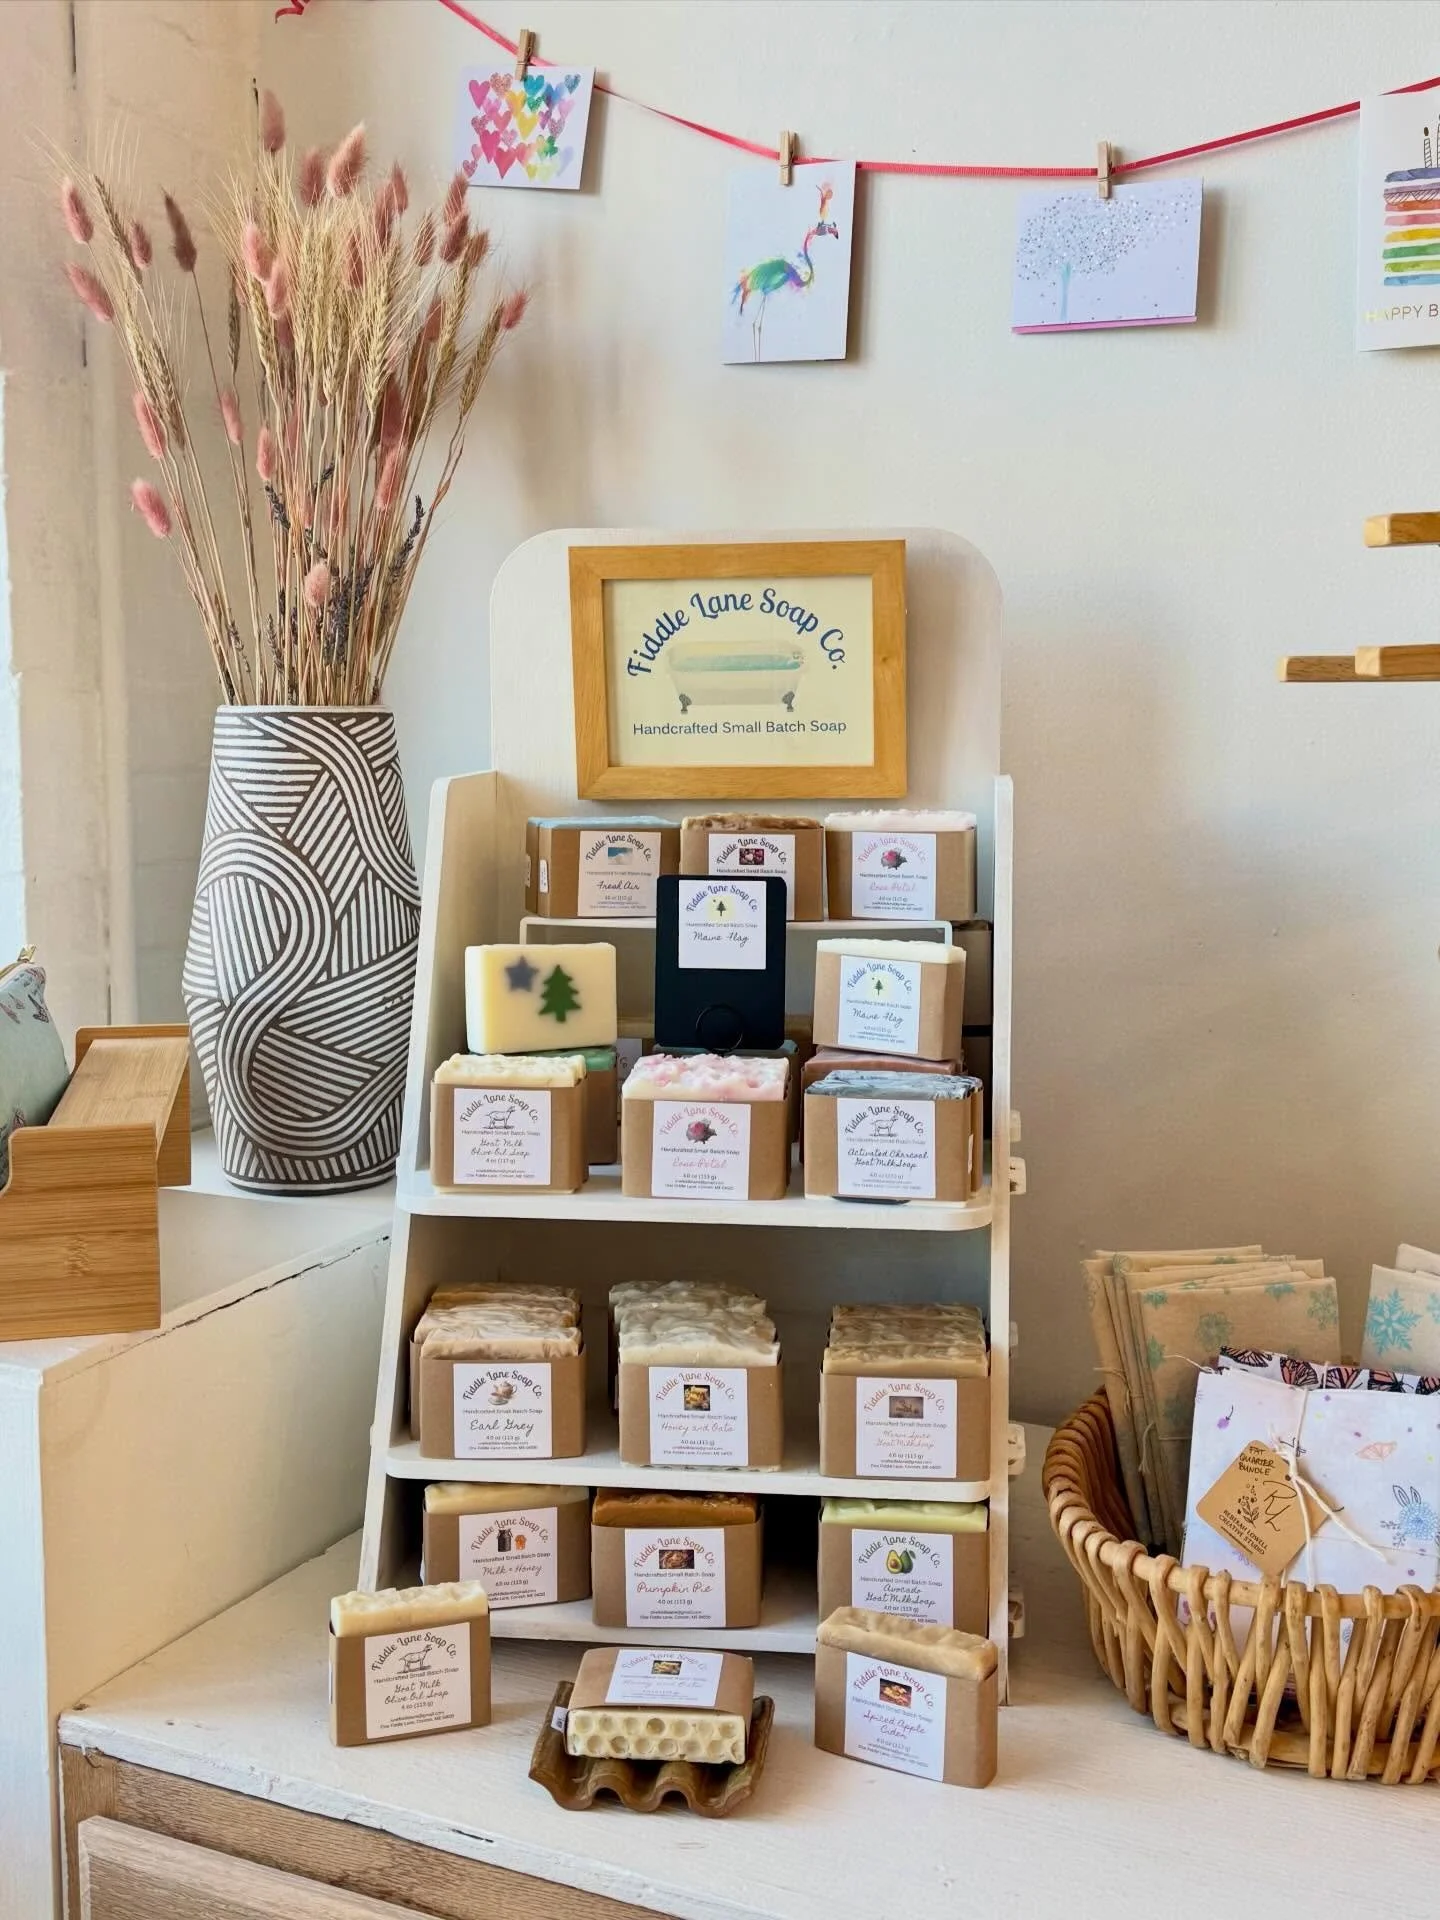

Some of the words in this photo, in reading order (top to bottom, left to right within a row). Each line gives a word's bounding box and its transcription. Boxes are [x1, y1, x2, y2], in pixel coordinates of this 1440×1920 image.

[627, 608, 689, 677] Fiddle
[691, 591, 754, 619] Lane
[760, 588, 819, 635] Soap
[819, 628, 846, 670] Co.
[633, 722, 717, 735] Handcrafted
[722, 722, 761, 733] Small
[766, 721, 806, 732] Batch
[810, 720, 847, 734] Soap
[585, 840, 606, 861] Fiddle
[606, 835, 626, 843] Lane
[627, 834, 644, 850] Soap
[717, 844, 738, 863] Fiddle
[760, 838, 778, 853] Soap
[778, 852, 786, 864] Co.
[858, 842, 878, 863] Fiddle
[900, 838, 918, 852] Soap
[597, 881, 622, 889] Fresh
[624, 881, 640, 889] Air
[686, 891, 708, 911] Fiddle
[708, 885, 728, 894] Lane
[730, 885, 749, 900] Soap
[693, 932, 722, 940] Maine
[726, 932, 749, 947] Flag
[848, 968, 867, 988] Fiddle
[867, 962, 885, 971] Lane
[888, 964, 904, 980] Soap
[853, 1008, 880, 1019] Maine
[883, 1013, 904, 1028] Flag
[460, 1100, 483, 1122] Fiddle
[484, 1094, 506, 1103] Lane
[508, 1094, 529, 1111] Soap
[845, 1111, 868, 1134] Fiddle
[868, 1106, 891, 1115] Lane
[893, 1106, 915, 1123] Soap
[660, 1113, 683, 1135] Fiddle
[684, 1107, 707, 1117] Lane
[709, 1107, 729, 1124] Soap
[509, 1149, 530, 1159] Soap
[848, 1148, 888, 1157] Activated
[890, 1149, 928, 1158] Charcoal
[463, 1377, 486, 1400] Fiddle
[486, 1371, 509, 1380] Lane
[512, 1370, 532, 1387] Soap
[532, 1385, 542, 1399] Co.
[656, 1378, 679, 1400] Fiddle
[679, 1372, 702, 1382] Lane
[704, 1372, 725, 1389] Soap
[864, 1389, 888, 1412] Fiddle
[888, 1383, 912, 1392] Lane
[914, 1383, 935, 1400] Soap
[470, 1420, 499, 1430] Earl
[504, 1419, 534, 1437] Grey
[661, 1422, 689, 1437] Honey
[692, 1423, 710, 1431] and
[711, 1422, 735, 1432] Oats
[1240, 1453, 1275, 1468] QUARTER
[1250, 1446, 1266, 1455] FAT
[1239, 1462, 1271, 1475] BUNDLE
[471, 1526, 494, 1550] Fiddle
[495, 1519, 517, 1528] Lane
[519, 1517, 539, 1532] Soap
[539, 1529, 549, 1543] Co.
[1219, 1515, 1243, 1538] CREATIVE
[1244, 1536, 1264, 1555] STUDIO
[1223, 1510, 1247, 1535] REBEKAH
[1247, 1529, 1268, 1550] LOWELL
[634, 1544, 658, 1568] Fiddle
[658, 1537, 681, 1547] Lane
[683, 1537, 704, 1553] Soap
[858, 1542, 882, 1563] Fiddle
[883, 1536, 907, 1545] Lane
[909, 1536, 930, 1554] Soap
[931, 1553, 940, 1568] Co.
[482, 1566, 507, 1576] Milk
[514, 1565, 542, 1576] Honey
[637, 1582, 689, 1597] Pumpkin
[692, 1582, 712, 1593] Pie
[865, 1592, 889, 1601] Goat
[883, 1584, 923, 1594] Avocado
[372, 1644, 397, 1671] Fiddle
[397, 1634, 421, 1646] Lane
[424, 1632, 446, 1648] Soap
[395, 1682, 416, 1693] Goat
[420, 1680, 441, 1689] Milk
[854, 1670, 877, 1690] Fiddle
[878, 1665, 901, 1677] Lane
[902, 1669, 925, 1693] Soap
[385, 1696, 407, 1704] Olive
[410, 1692, 424, 1700] Oil
[427, 1690, 448, 1699] Soap
[863, 1710, 895, 1723] Spiced
[897, 1720, 926, 1734] Apple
[880, 1724, 906, 1739] Cider
